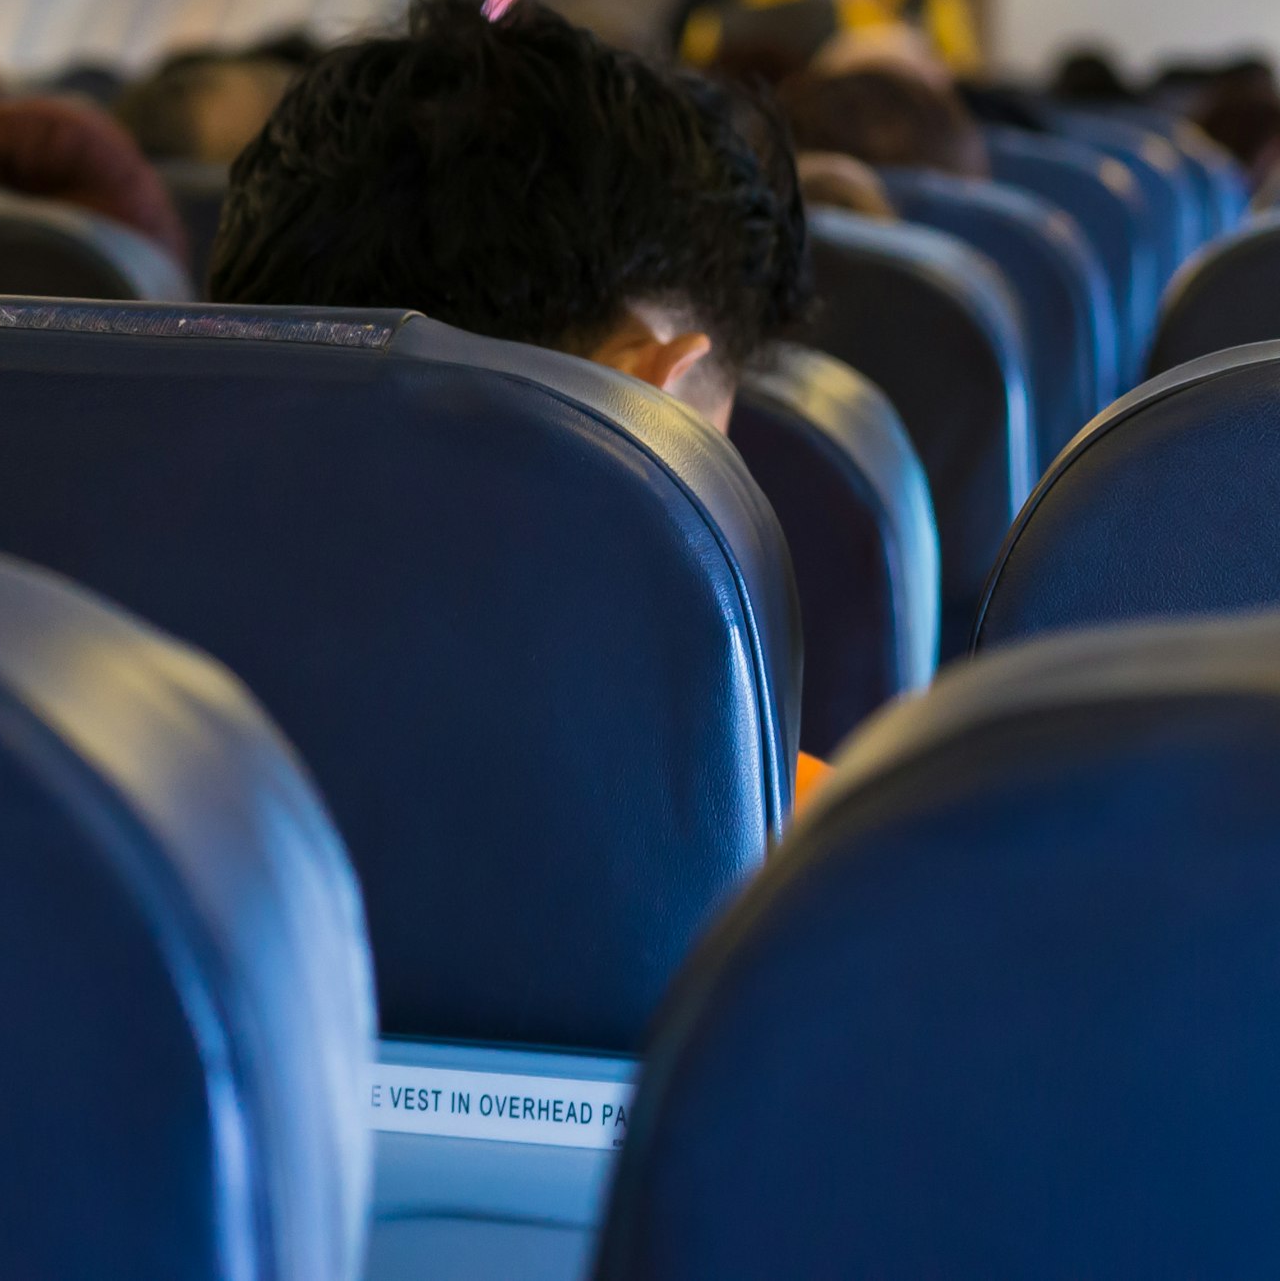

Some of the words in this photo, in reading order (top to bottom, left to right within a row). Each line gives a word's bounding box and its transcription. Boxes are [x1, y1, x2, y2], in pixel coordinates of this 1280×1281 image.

[390, 1086, 442, 1113] VEST
[450, 1091, 471, 1115] IN
[479, 1093, 593, 1125] OVERHEAD
